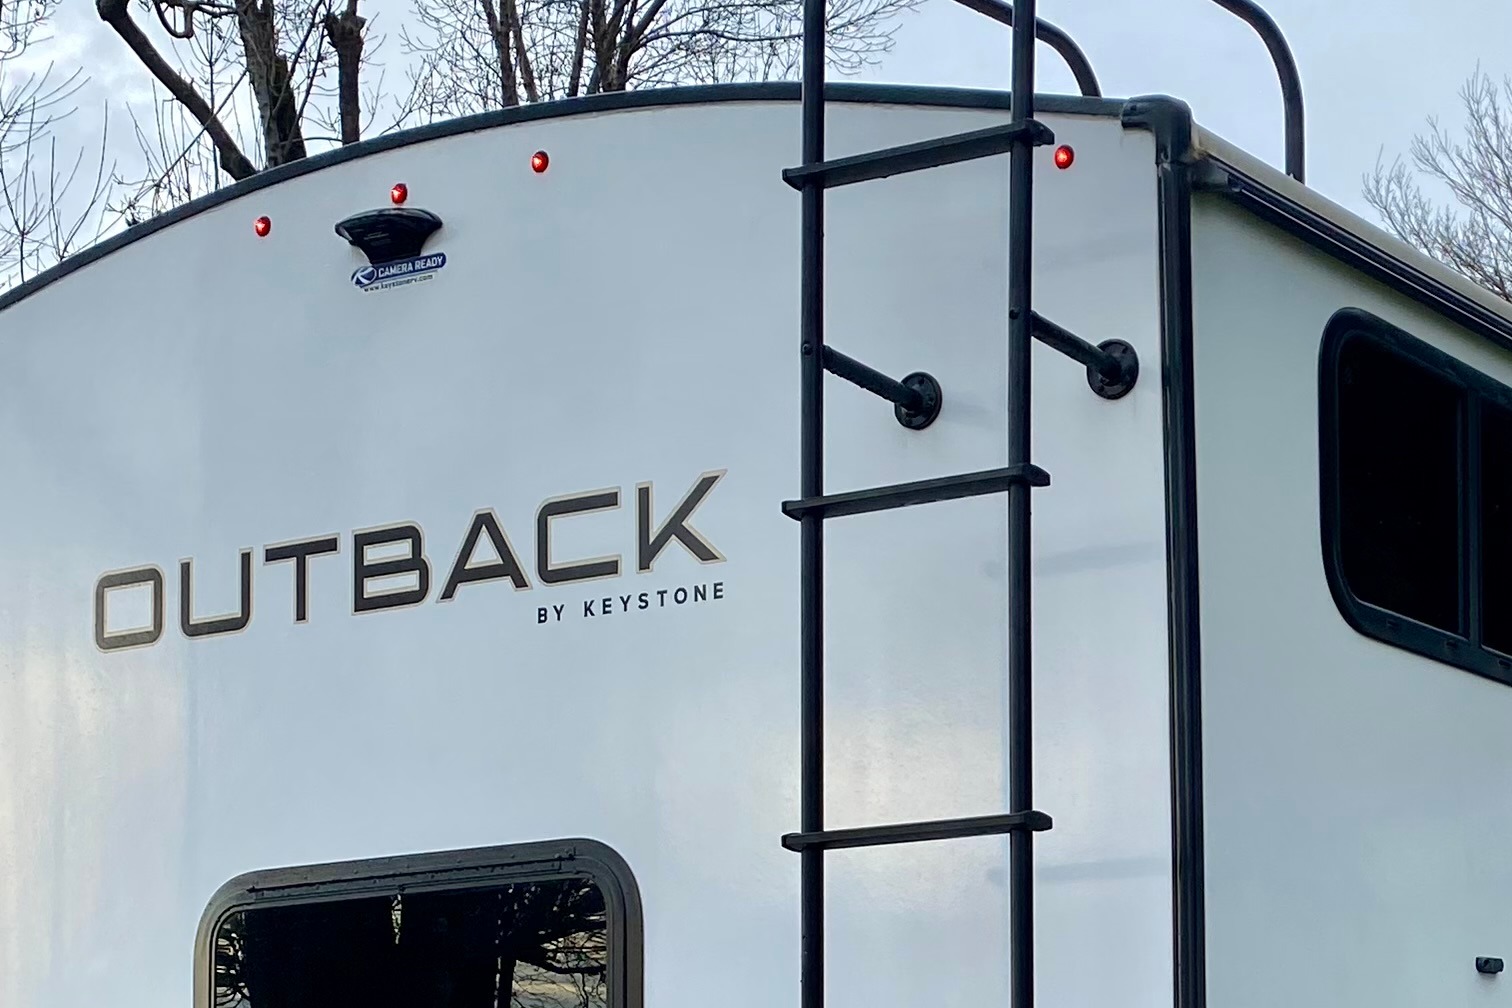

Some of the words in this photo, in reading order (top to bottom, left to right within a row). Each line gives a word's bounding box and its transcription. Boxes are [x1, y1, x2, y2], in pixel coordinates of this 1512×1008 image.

[378, 262, 413, 278] CAMERA
[414, 256, 443, 270] READY
[93, 469, 728, 654] OUTBACK
[537, 603, 565, 624] BY
[583, 582, 726, 618] KEYSTONE
